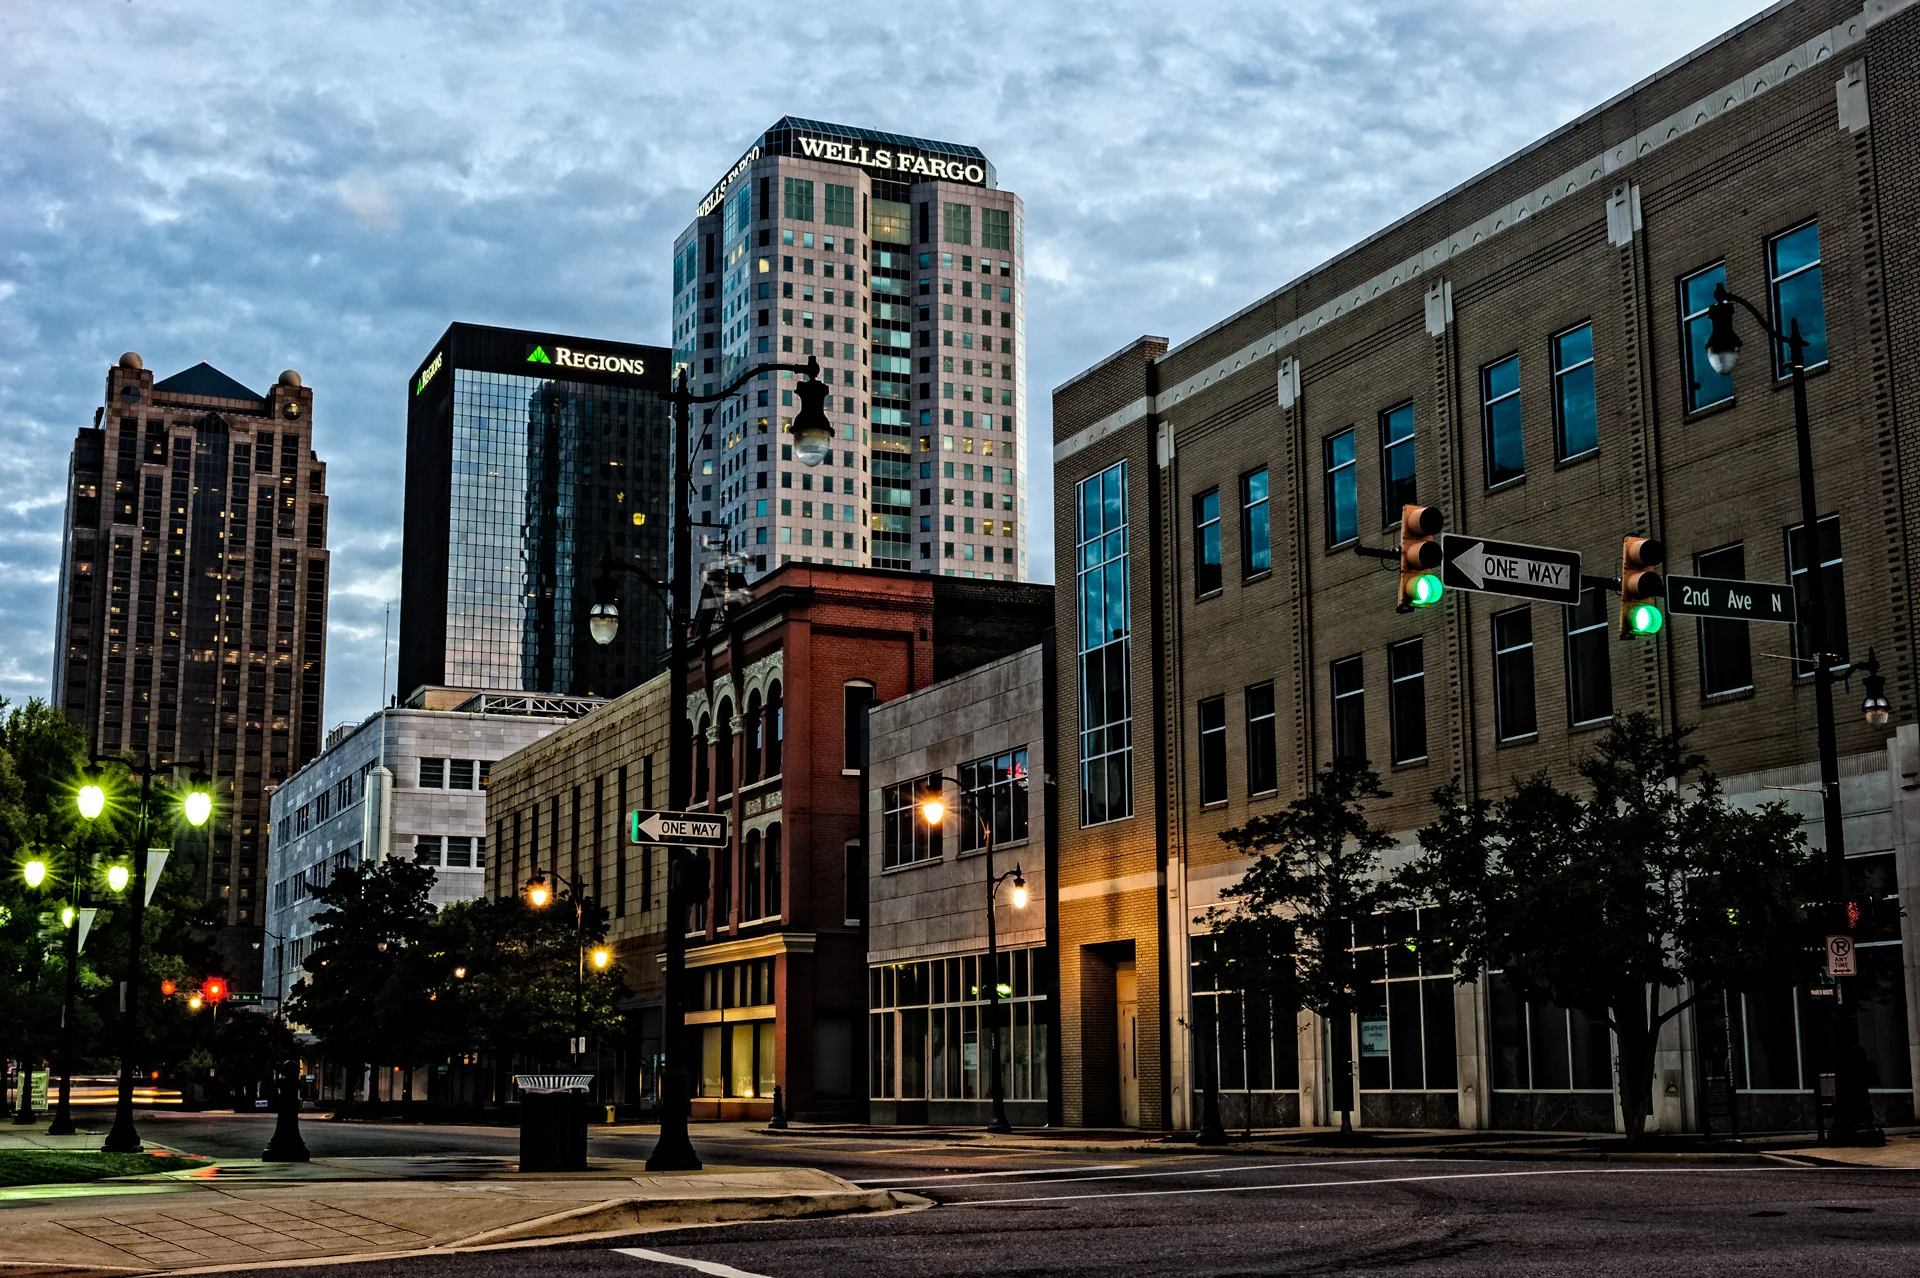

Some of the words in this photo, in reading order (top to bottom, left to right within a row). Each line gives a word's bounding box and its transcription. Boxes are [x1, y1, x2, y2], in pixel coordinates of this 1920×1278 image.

[798, 137, 892, 169] WELLS
[897, 153, 984, 183] FARGO
[1484, 556, 1519, 580] ONE
[1527, 562, 1564, 586] WAY
[1683, 586, 1710, 607] 2nd
[1727, 590, 1752, 611] Ave
[1771, 594, 1782, 613] N
[661, 822, 687, 835] ONE
[691, 823, 718, 837] WAY
